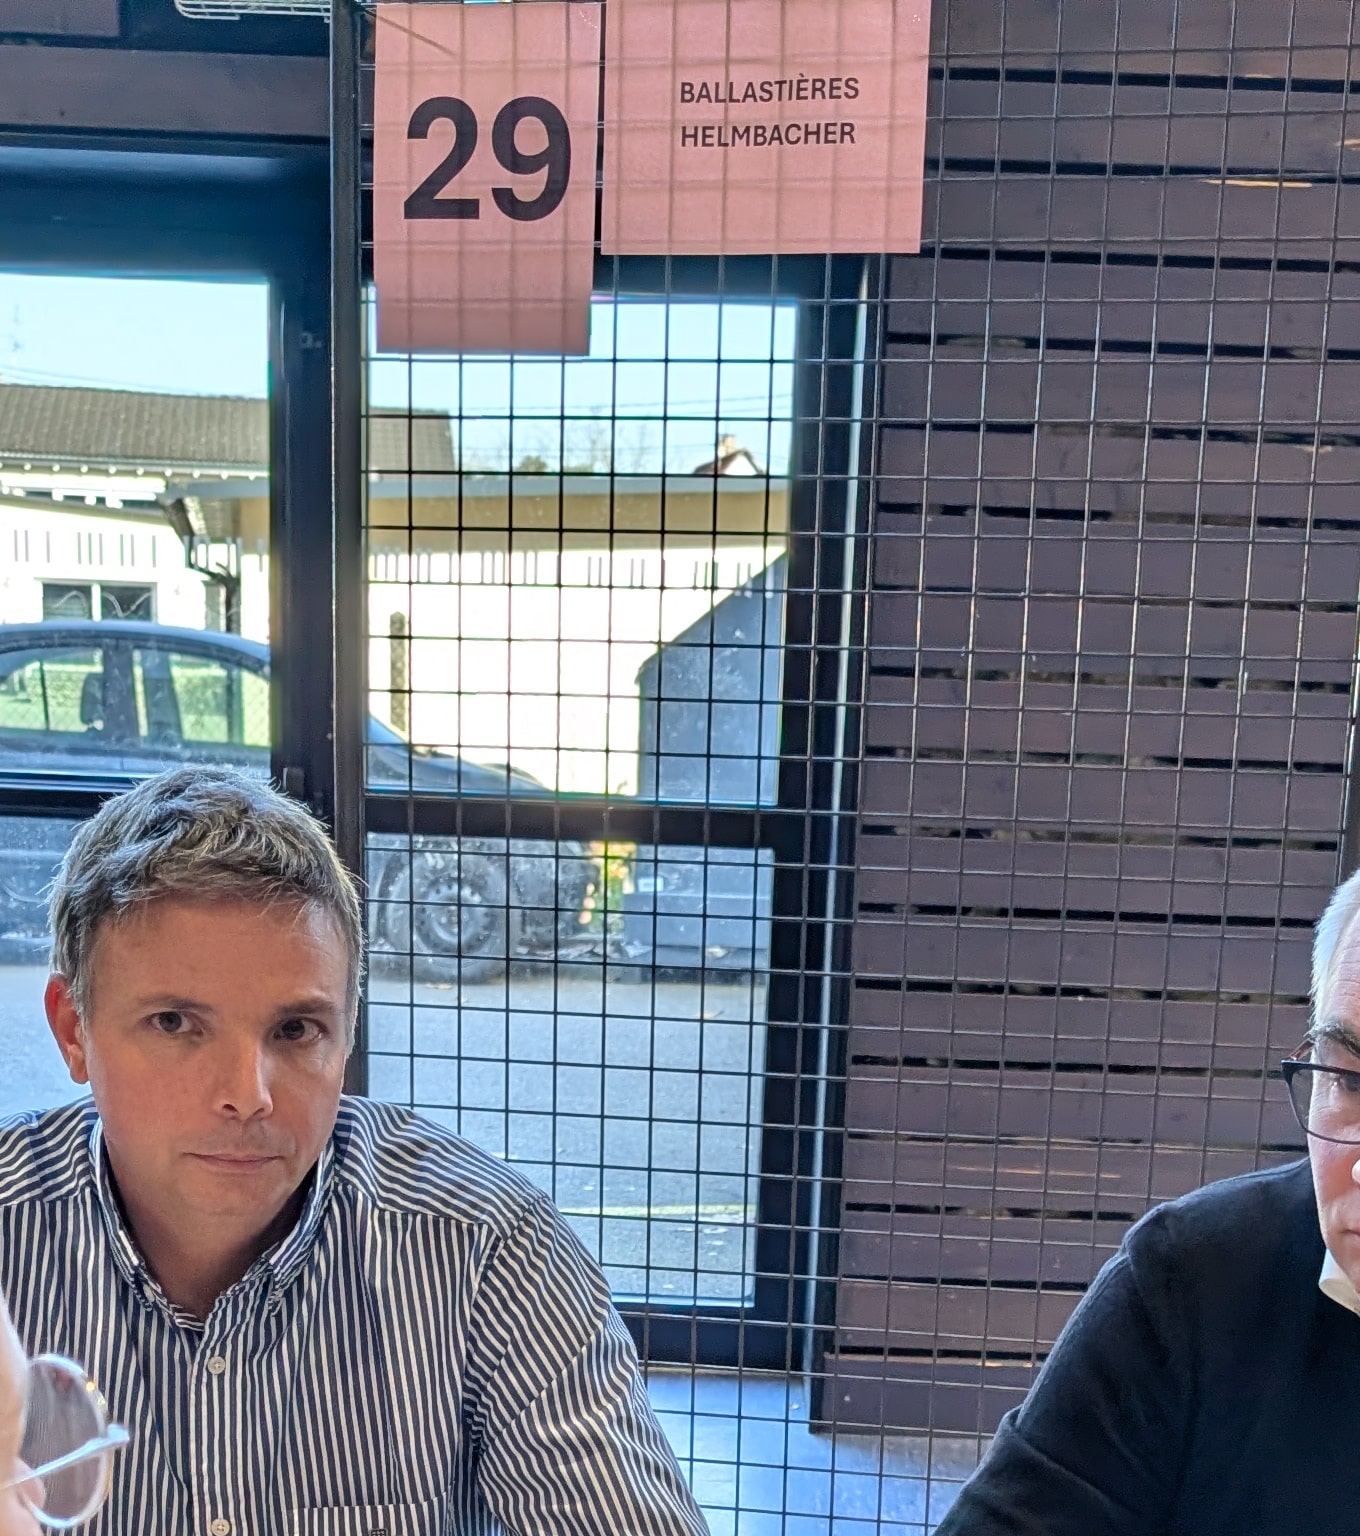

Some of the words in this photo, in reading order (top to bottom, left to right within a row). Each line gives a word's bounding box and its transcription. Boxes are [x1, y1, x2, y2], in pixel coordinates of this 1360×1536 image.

[680, 74, 860, 106] BALLASTIÈRES
[680, 121, 857, 149] HELMBACHER
[403, 95, 571, 221] 29
